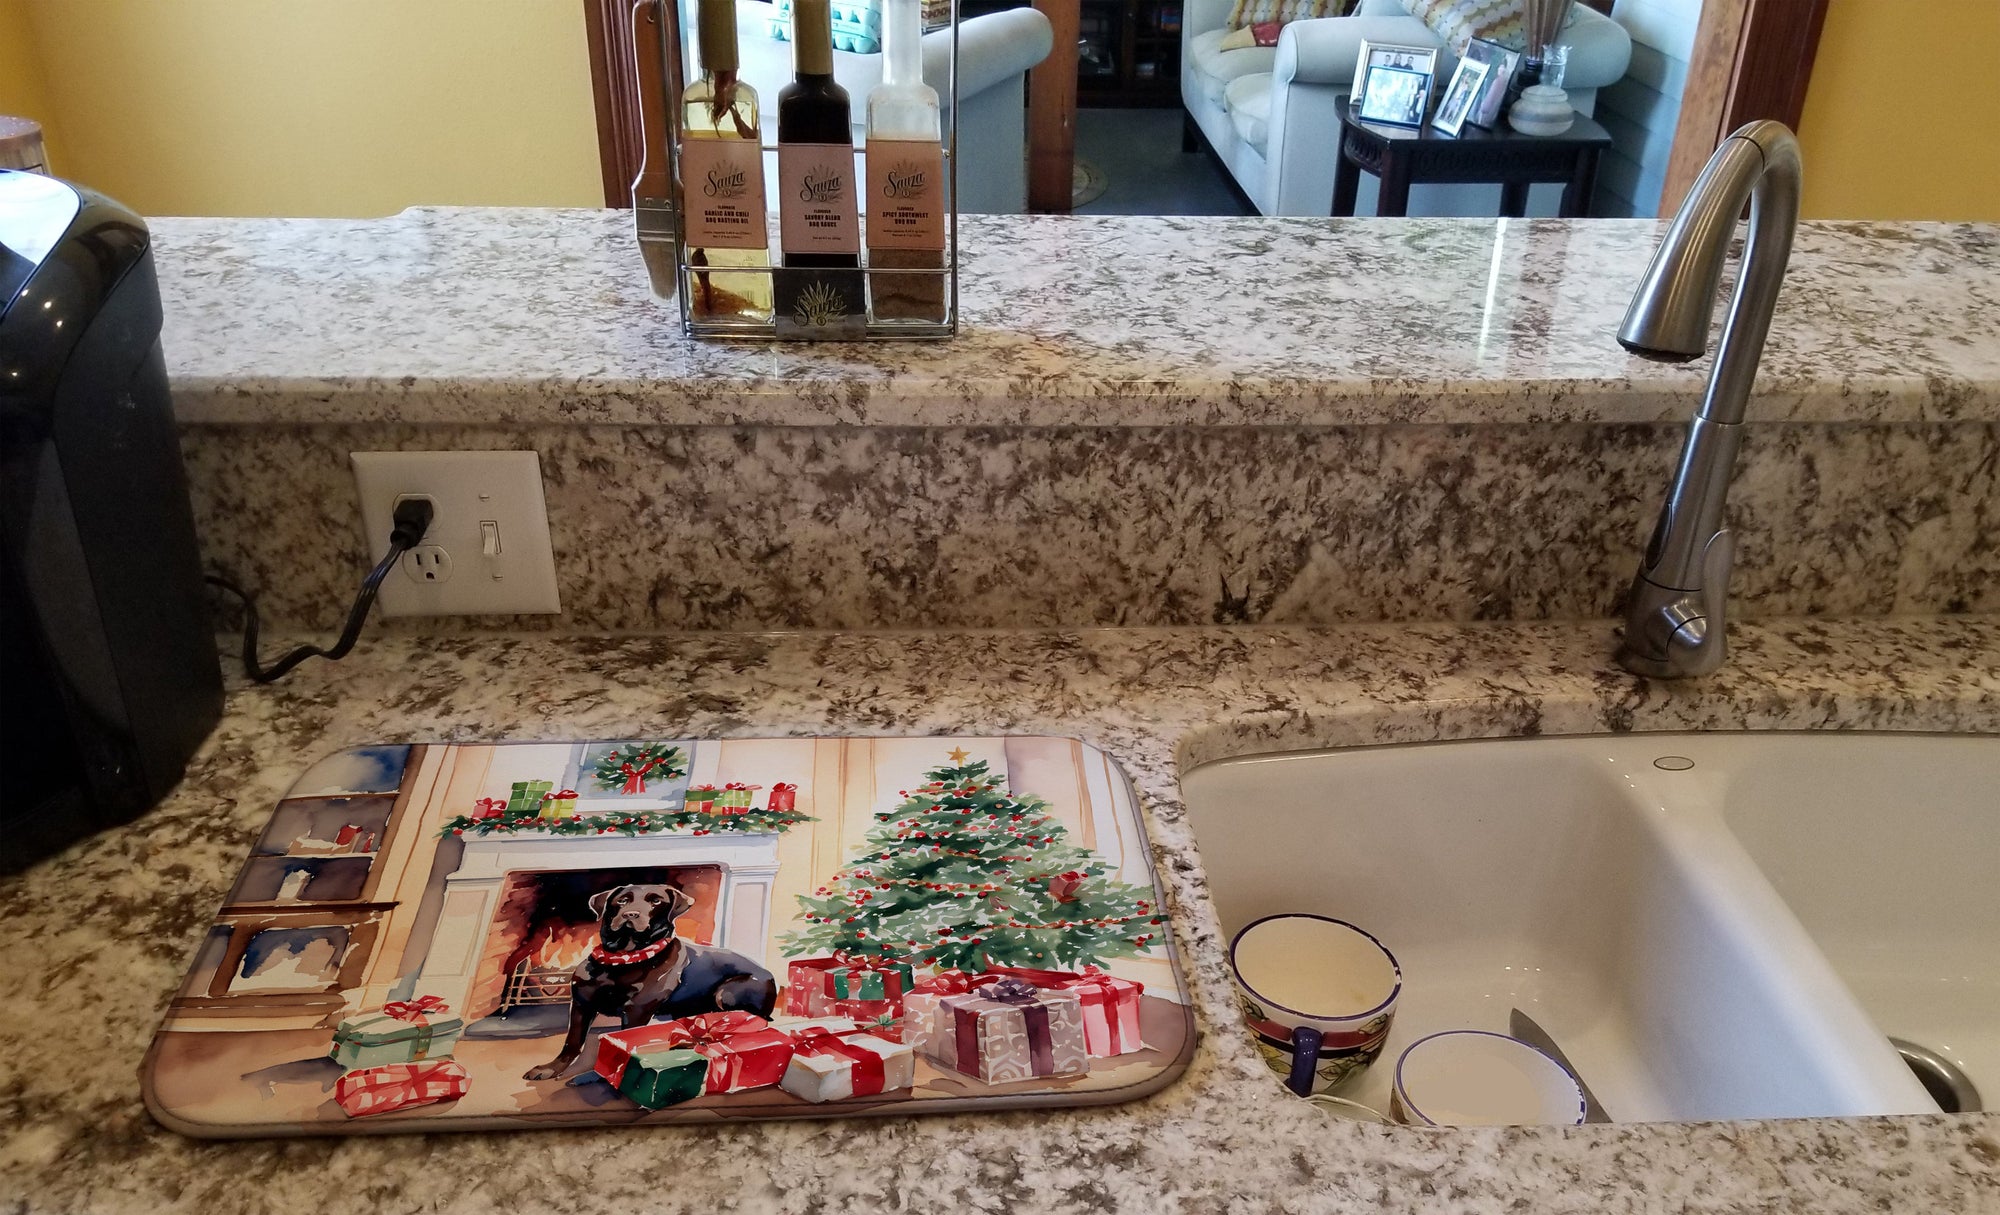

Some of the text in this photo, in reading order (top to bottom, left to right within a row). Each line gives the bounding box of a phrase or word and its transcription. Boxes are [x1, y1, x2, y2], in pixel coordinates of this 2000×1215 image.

[704, 170, 745, 197] Sauza
[800, 175, 841, 202] Sauza
[884, 171, 924, 198] Sauza
[793, 296, 843, 326] Sauza
